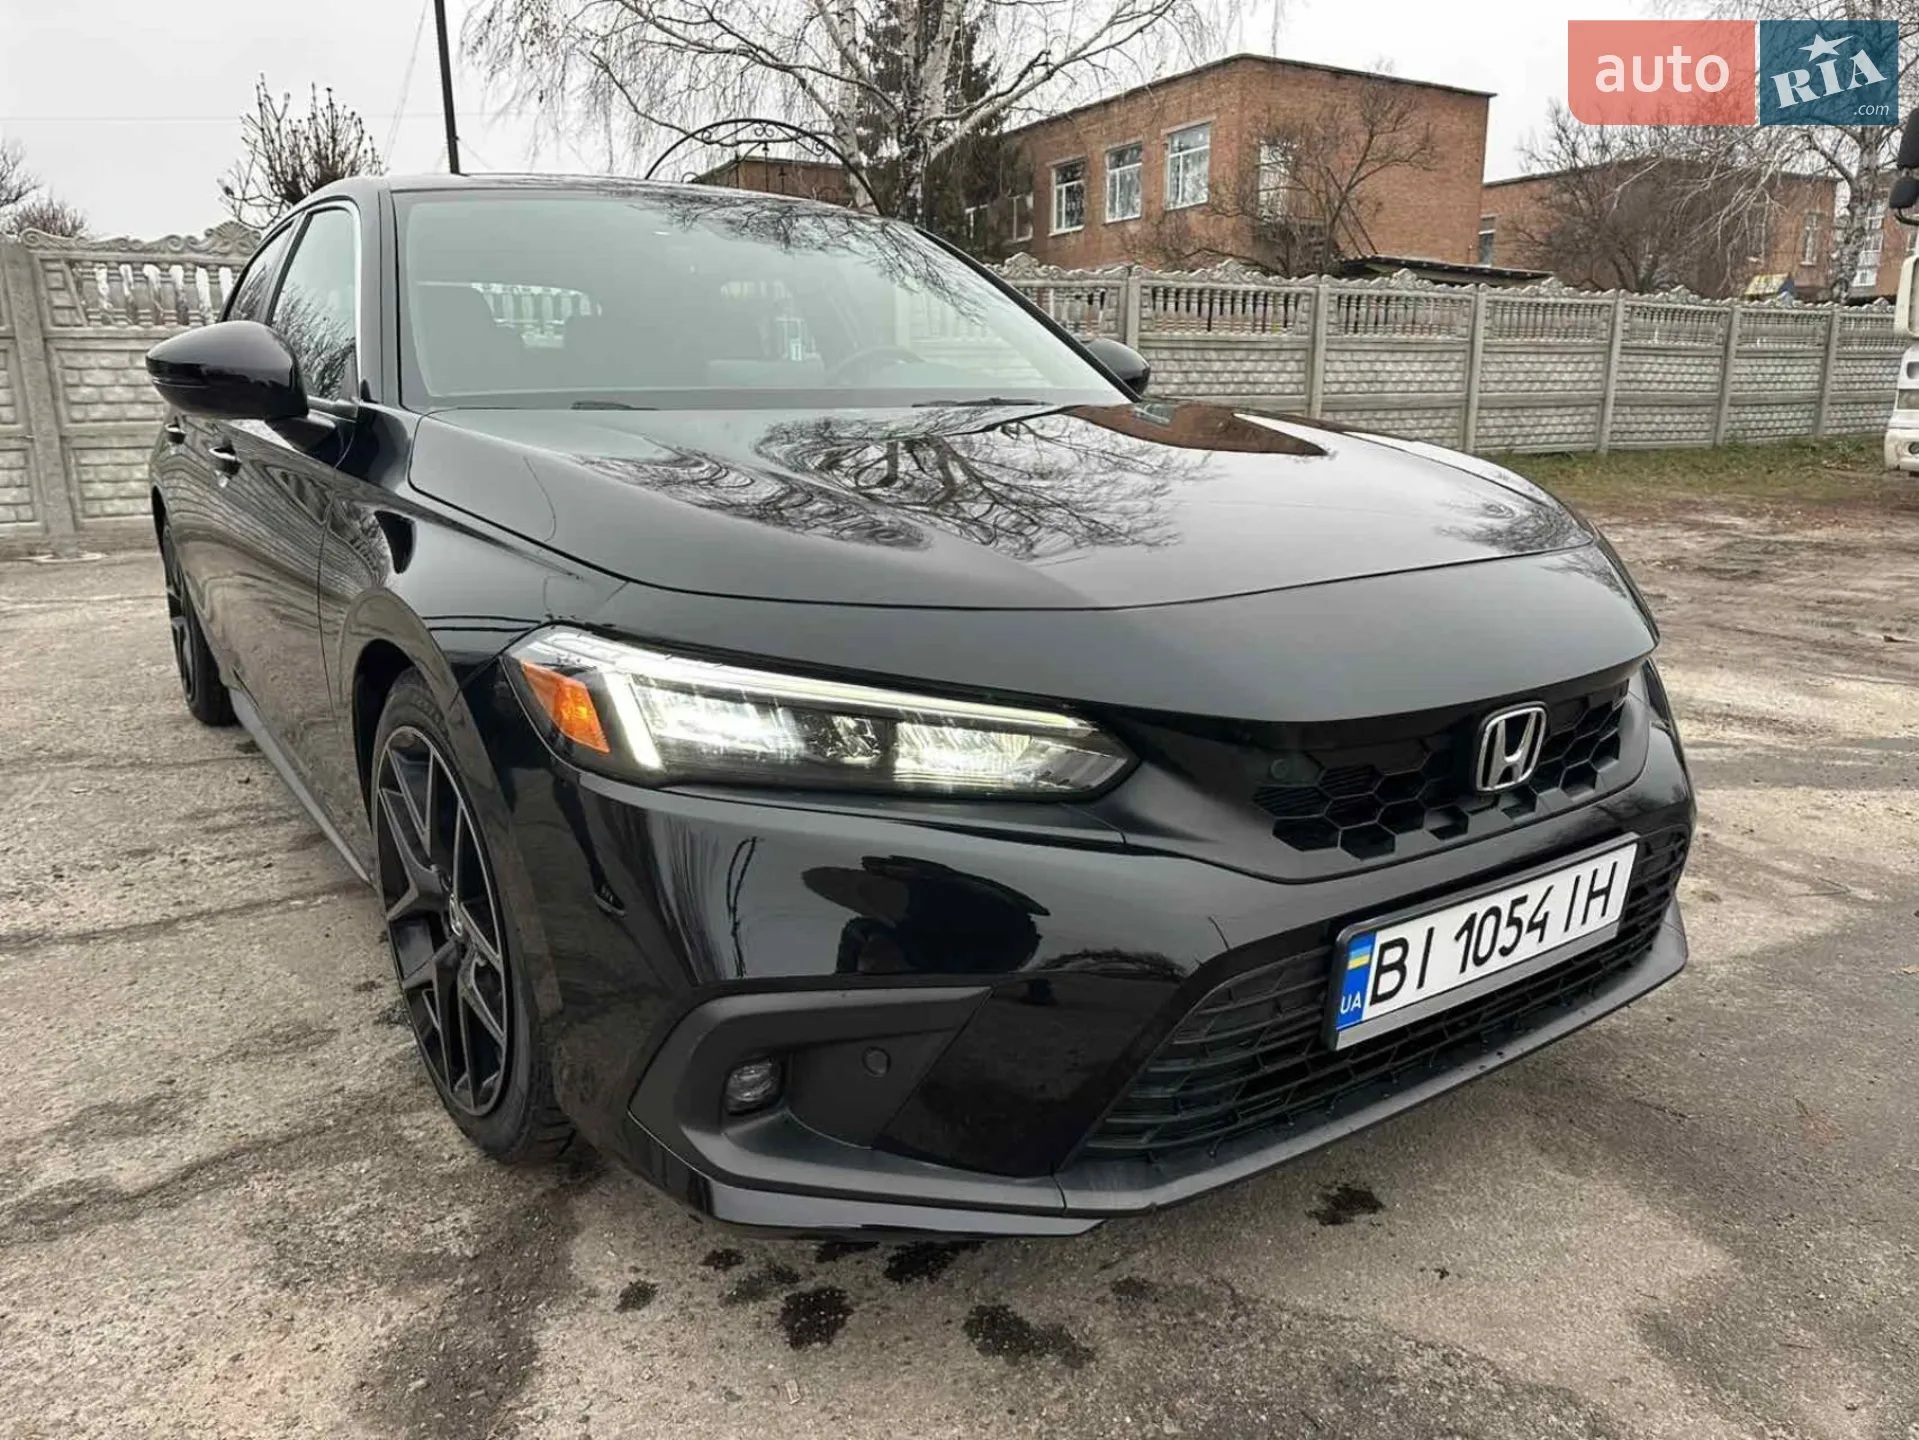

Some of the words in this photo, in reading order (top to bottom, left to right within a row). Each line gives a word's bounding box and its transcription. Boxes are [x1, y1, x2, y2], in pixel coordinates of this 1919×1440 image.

[1369, 926, 1435, 1007] BI
[1454, 884, 1555, 975] 1054
[1564, 861, 1619, 933] IH
[1340, 991, 1362, 1015] UA
